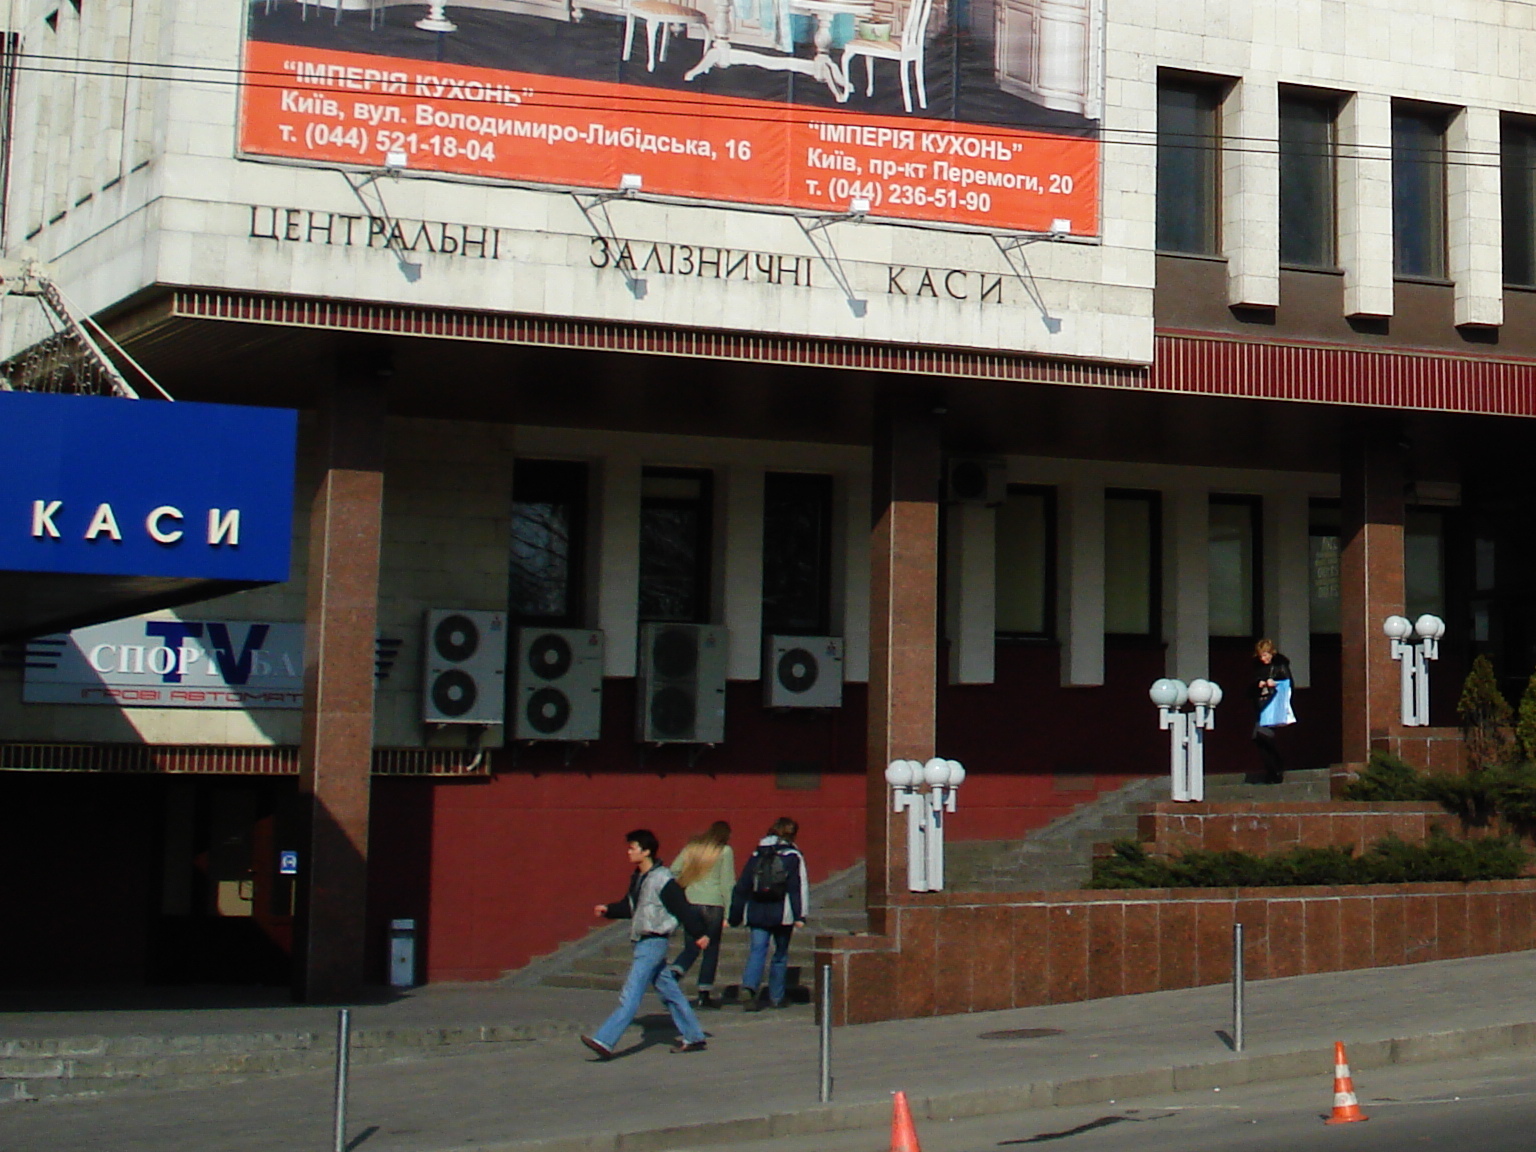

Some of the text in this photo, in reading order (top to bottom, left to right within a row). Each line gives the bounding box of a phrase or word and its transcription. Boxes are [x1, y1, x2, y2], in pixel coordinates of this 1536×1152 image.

[279, 122, 496, 164] т. (044) 521-18-04
[281, 91, 752, 162] Київ, вул. Володимиро-Либідська, 16
[806, 147, 1075, 196] Київ, пр-кт Перемоги, 20
[806, 179, 992, 214] т. (044) 236-51-90
[249, 205, 1004, 305] ЦЕНТРАЛЬНІ ЗАЛІЗНИЧНІ КАСИ
[31, 500, 241, 546] КАСИ
[146, 621, 270, 684] TV
[250, 647, 303, 677] БА
[170, 688, 303, 704] АВТОМАТ
